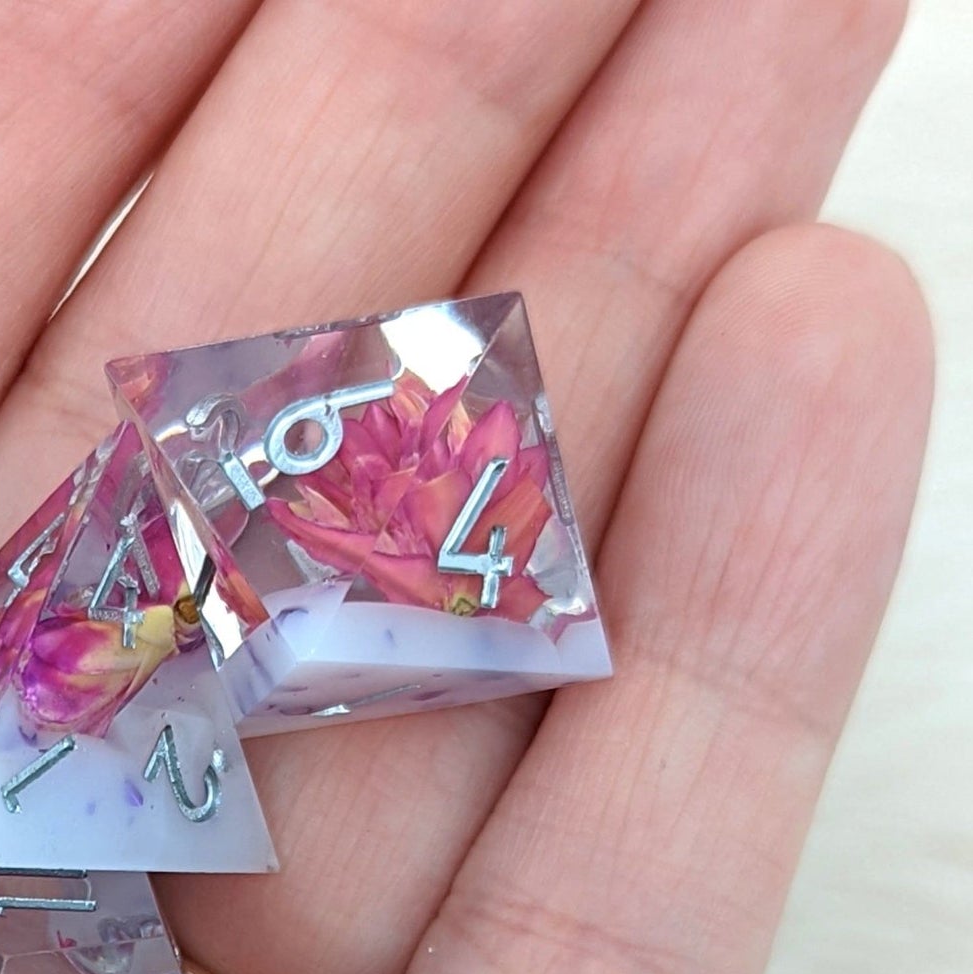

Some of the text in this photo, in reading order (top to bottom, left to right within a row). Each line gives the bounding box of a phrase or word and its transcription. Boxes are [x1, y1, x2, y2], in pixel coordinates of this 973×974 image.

[438, 457, 513, 608] 4
[88, 536, 145, 650] 4
[0, 735, 78, 813] 1
